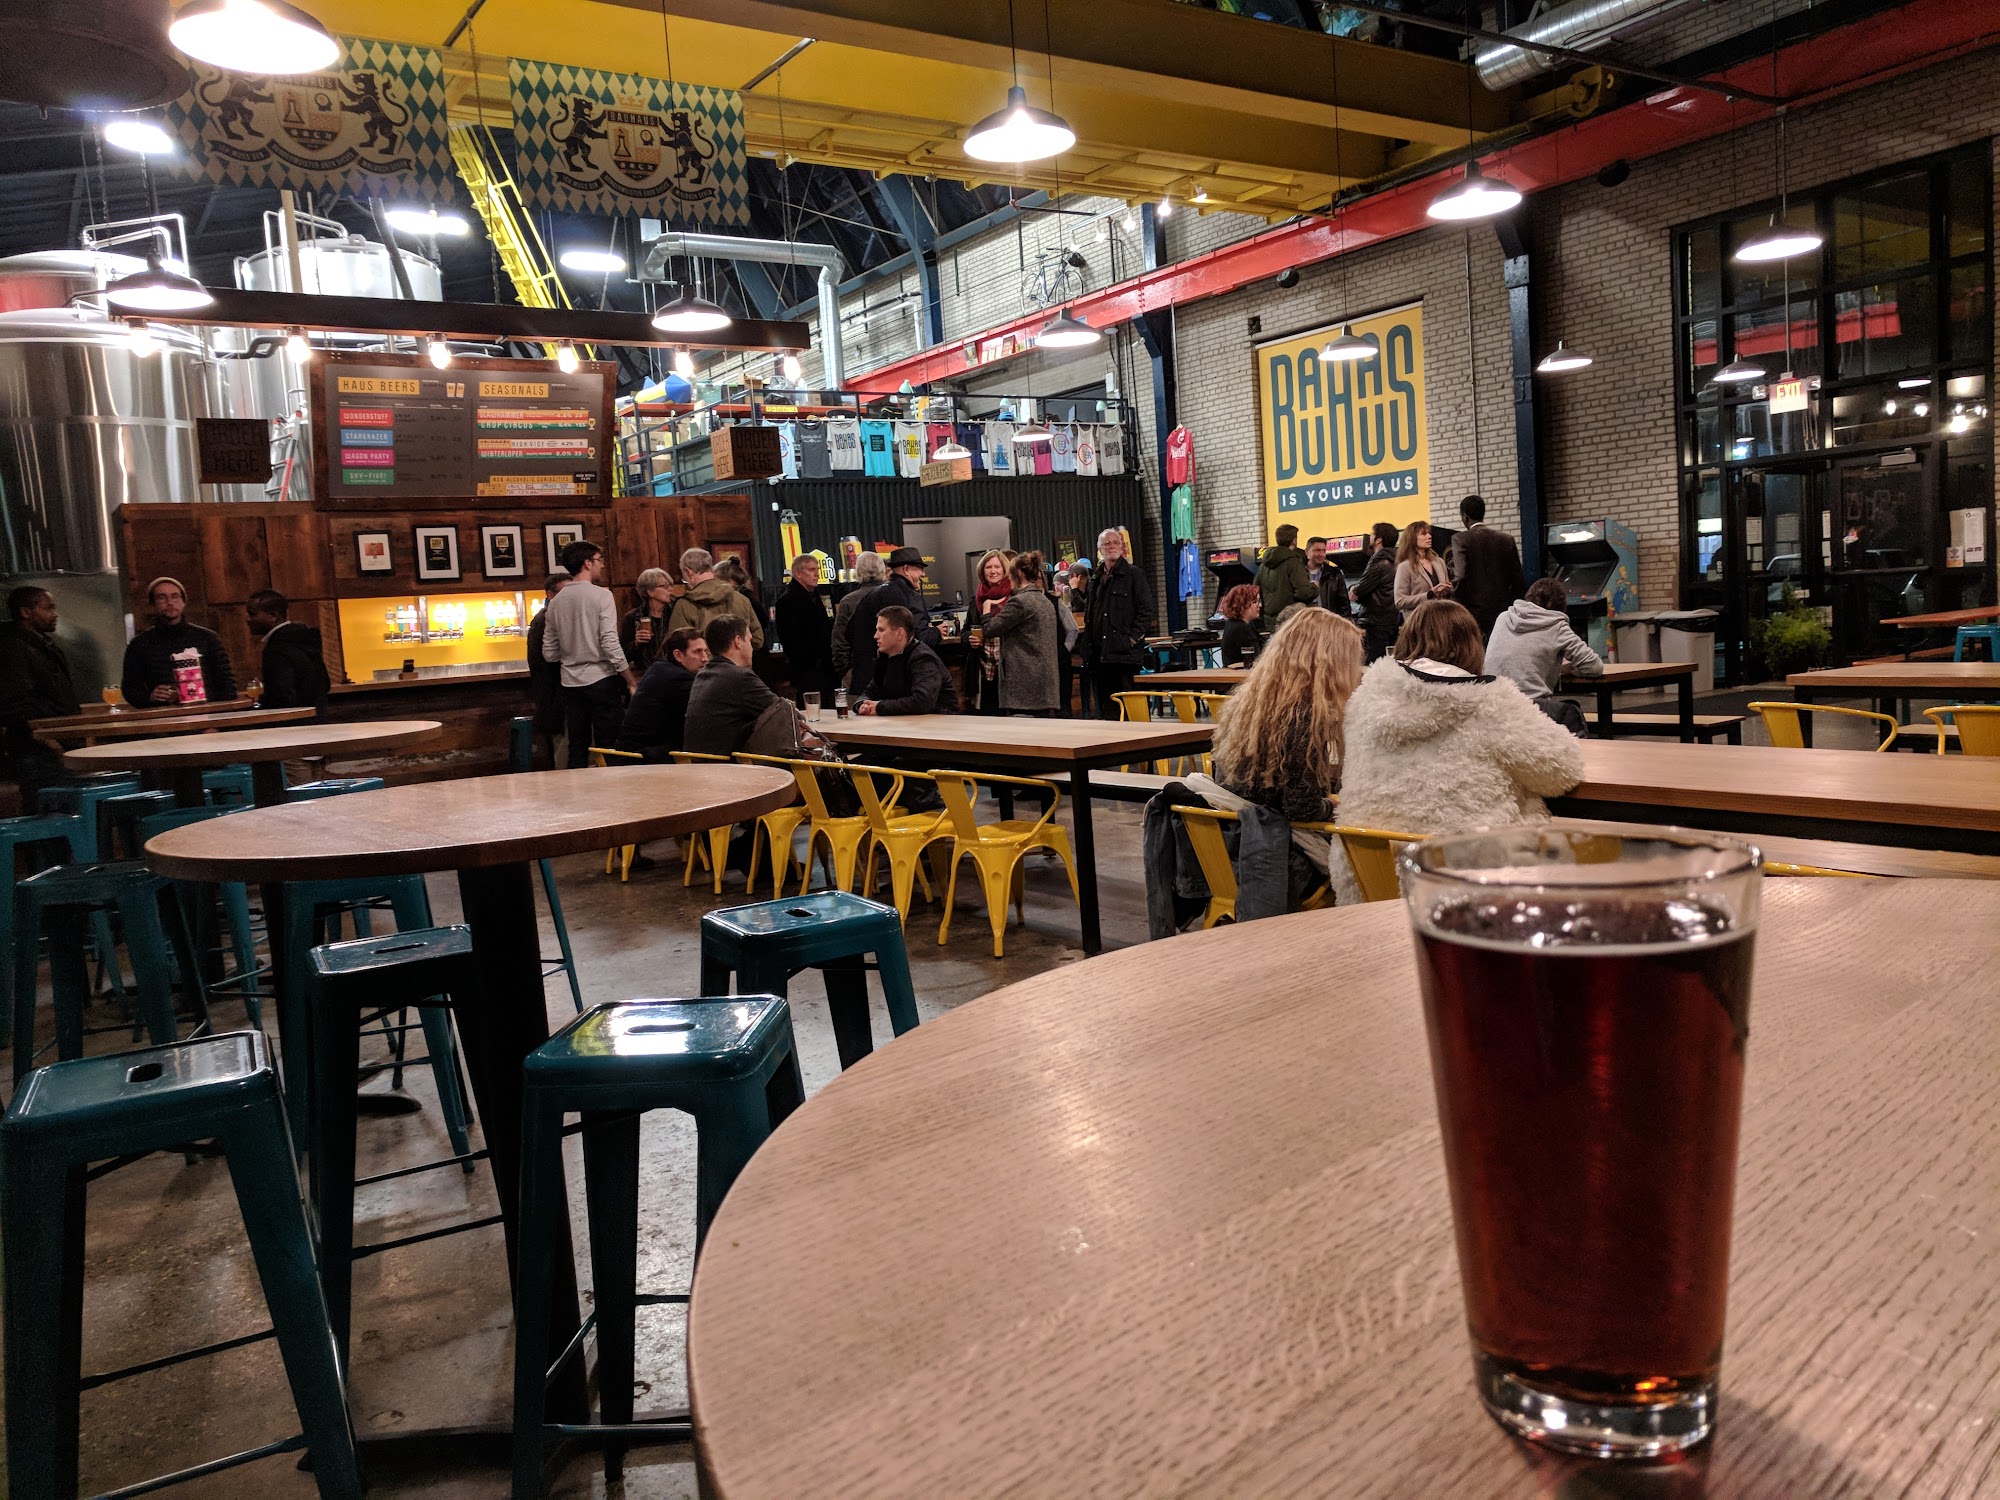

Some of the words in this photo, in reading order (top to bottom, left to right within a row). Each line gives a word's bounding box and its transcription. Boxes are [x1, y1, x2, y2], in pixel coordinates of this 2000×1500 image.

[610, 112, 655, 126] BAUHAUS
[343, 380, 373, 390] HAUS
[380, 381, 416, 393] BEERS
[484, 385, 544, 396] SEASONALS
[1776, 382, 1801, 400] EXIT
[343, 412, 389, 420] WONDERSTUFF
[736, 431, 776, 448] ORDER
[480, 450, 523, 458] WINTERLOPER
[743, 452, 772, 470] HERE
[1282, 493, 1297, 507] IS
[1306, 485, 1354, 503] YOUR
[1364, 476, 1413, 496] HAUS
[1344, 540, 1361, 549] JAM
